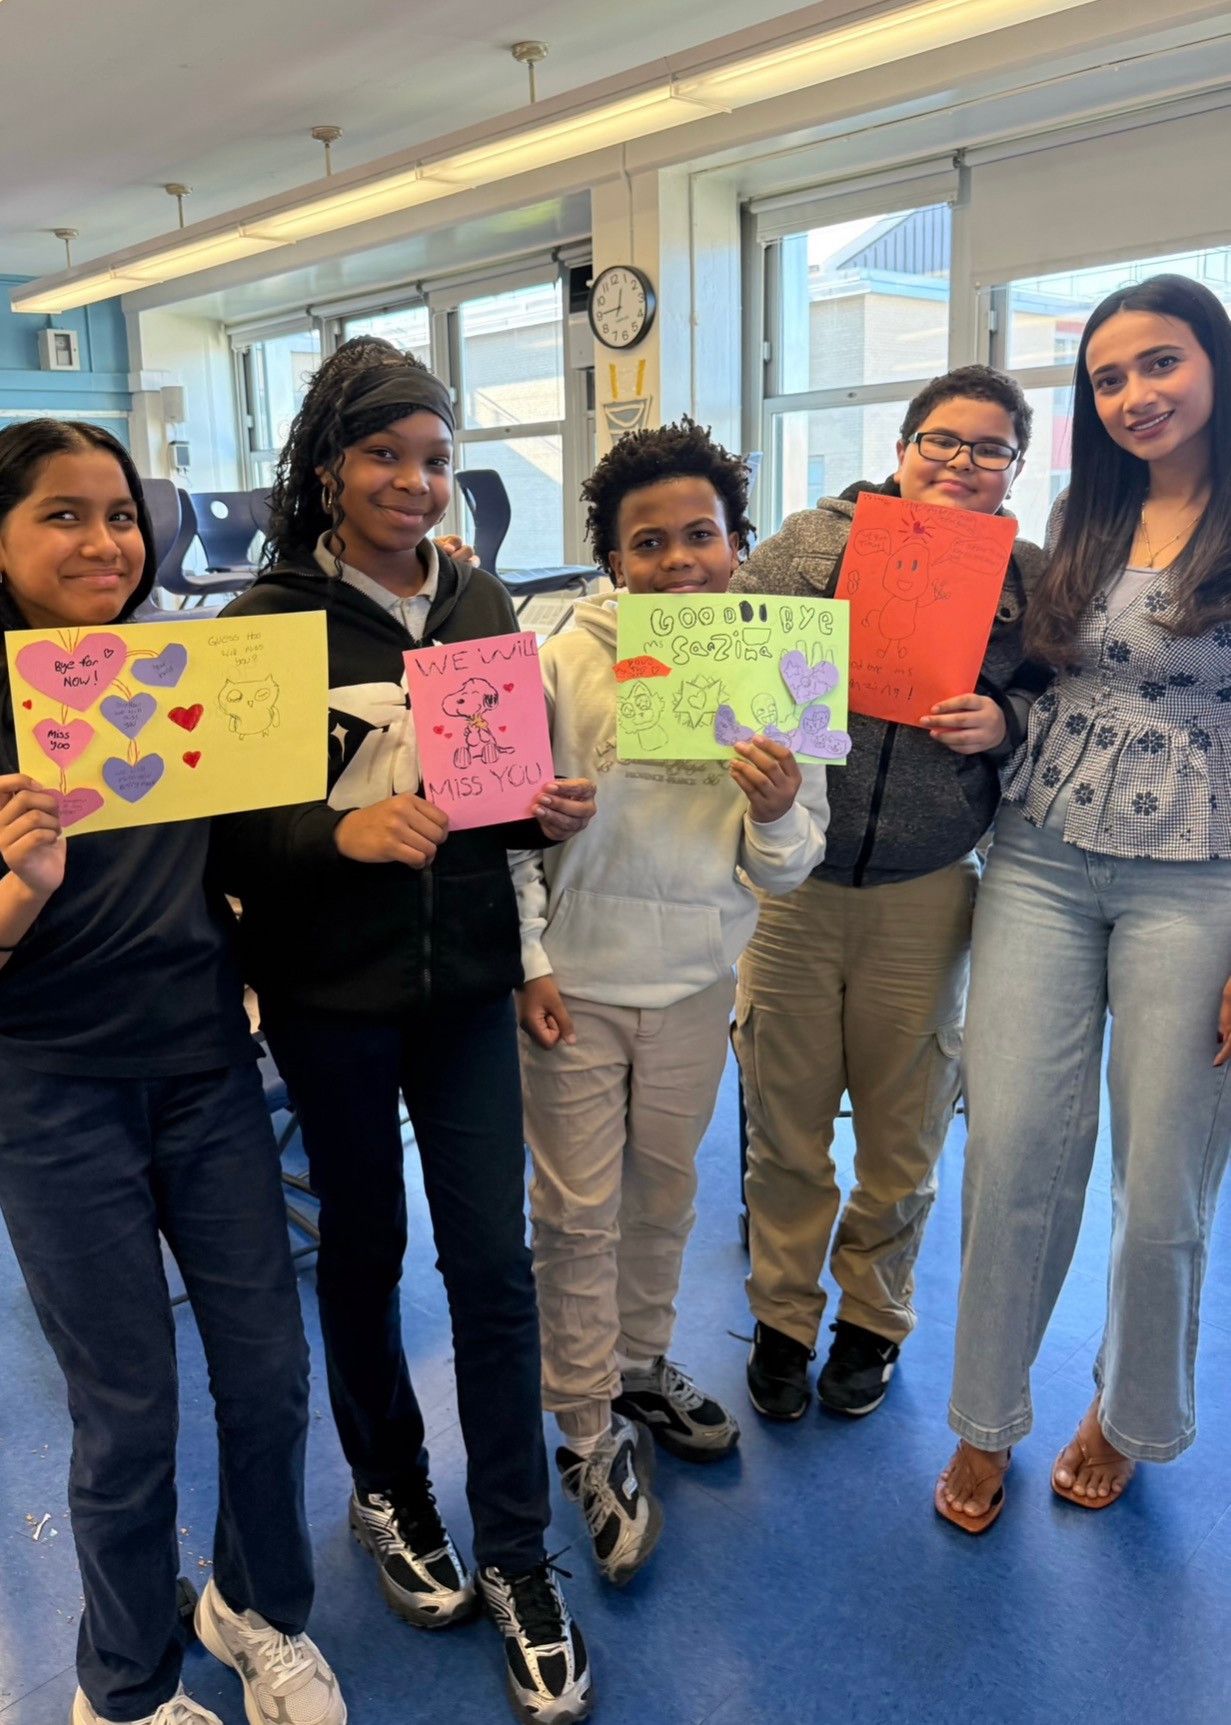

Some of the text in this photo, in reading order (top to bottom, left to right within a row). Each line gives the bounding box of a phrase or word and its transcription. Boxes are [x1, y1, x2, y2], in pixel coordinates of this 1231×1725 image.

[610, 274, 619, 285] 12
[631, 280, 638, 290] 2
[597, 296, 606, 306] 10
[637, 293, 644, 303] 3
[597, 311, 603, 321] 9
[637, 308, 643, 317] 4
[603, 324, 609, 333] 8
[631, 322, 639, 332] 5
[612, 331, 618, 341] 7
[622, 330, 629, 340] 6
[650, 606, 737, 637] GOOD
[79, 654, 99, 667] for
[415, 650, 469, 677] WE
[490, 762, 543, 793] YOU
